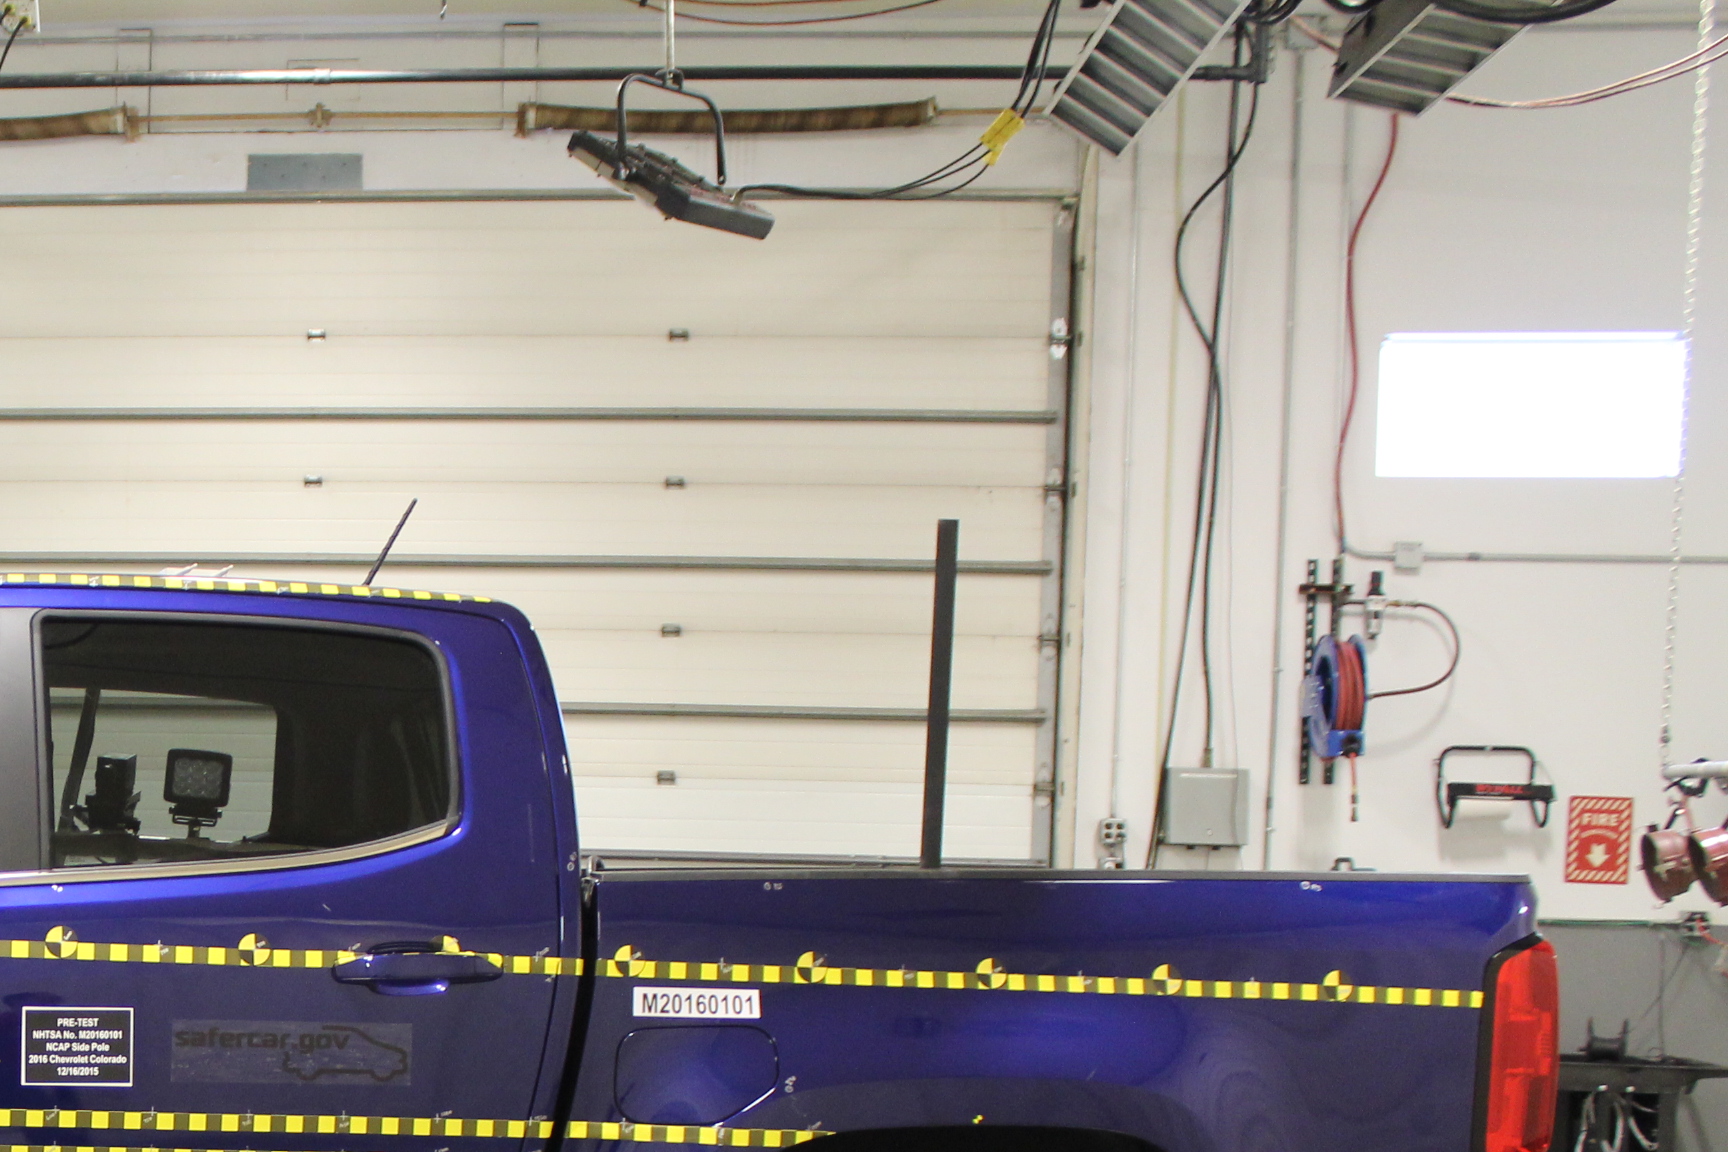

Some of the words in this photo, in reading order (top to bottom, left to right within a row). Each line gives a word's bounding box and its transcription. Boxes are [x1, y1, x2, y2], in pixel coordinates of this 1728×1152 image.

[1581, 812, 1621, 827] FIRE
[642, 993, 754, 1014] M20160101
[57, 1018, 99, 1027] PRE-TEST
[32, 1030, 62, 1039] NHTSA
[63, 1030, 77, 1039] No.
[79, 1030, 122, 1039] M20160101
[175, 1026, 351, 1054] safercar.gov
[46, 1042, 70, 1051] NCAP
[72, 1042, 89, 1051] Side
[91, 1042, 110, 1051] Pole
[28, 1055, 48, 1063] 2016
[49, 1054, 88, 1063] Chevrolet
[89, 1054, 128, 1064] Colorado
[56, 1067, 99, 1076] 12/16/2015
